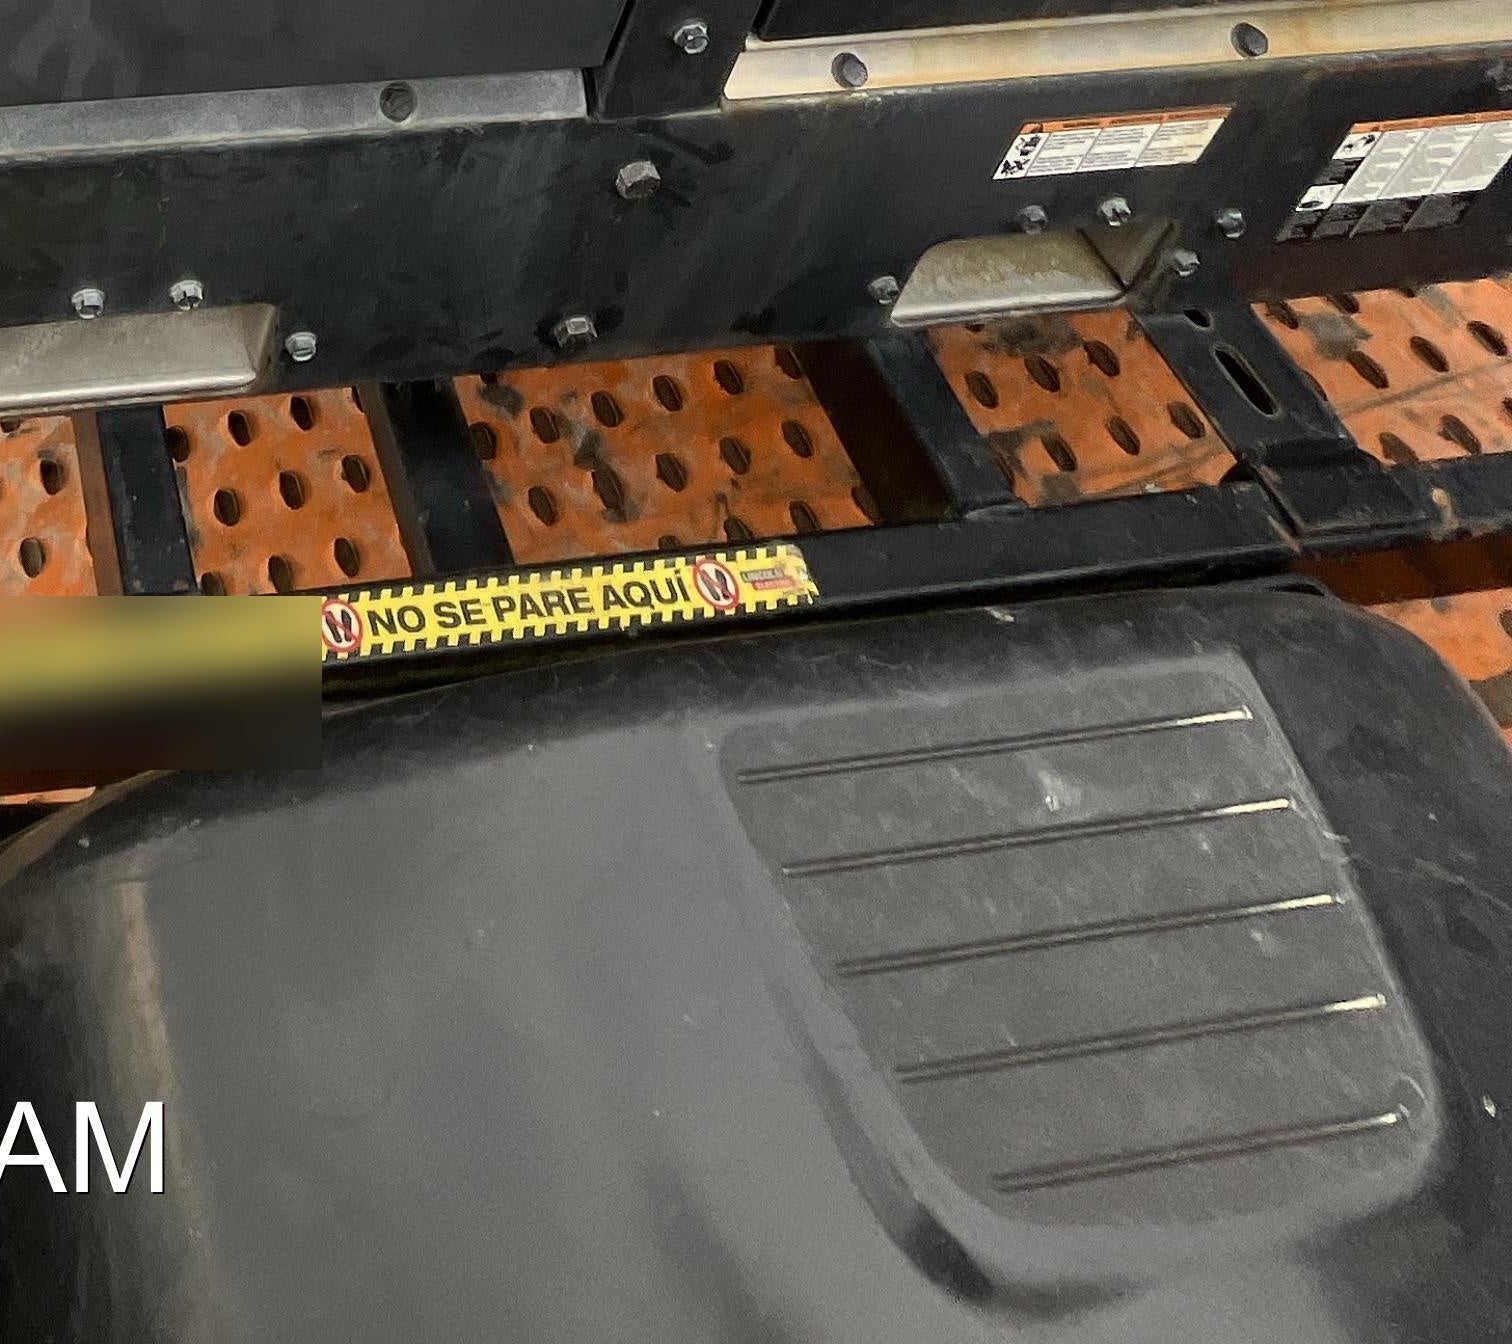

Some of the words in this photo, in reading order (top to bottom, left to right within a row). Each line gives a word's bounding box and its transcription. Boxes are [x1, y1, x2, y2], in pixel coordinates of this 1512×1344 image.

[368, 604, 427, 637] NO
[434, 597, 487, 630] SE
[492, 586, 595, 623] PARE
[602, 570, 692, 611] AQUÍ
